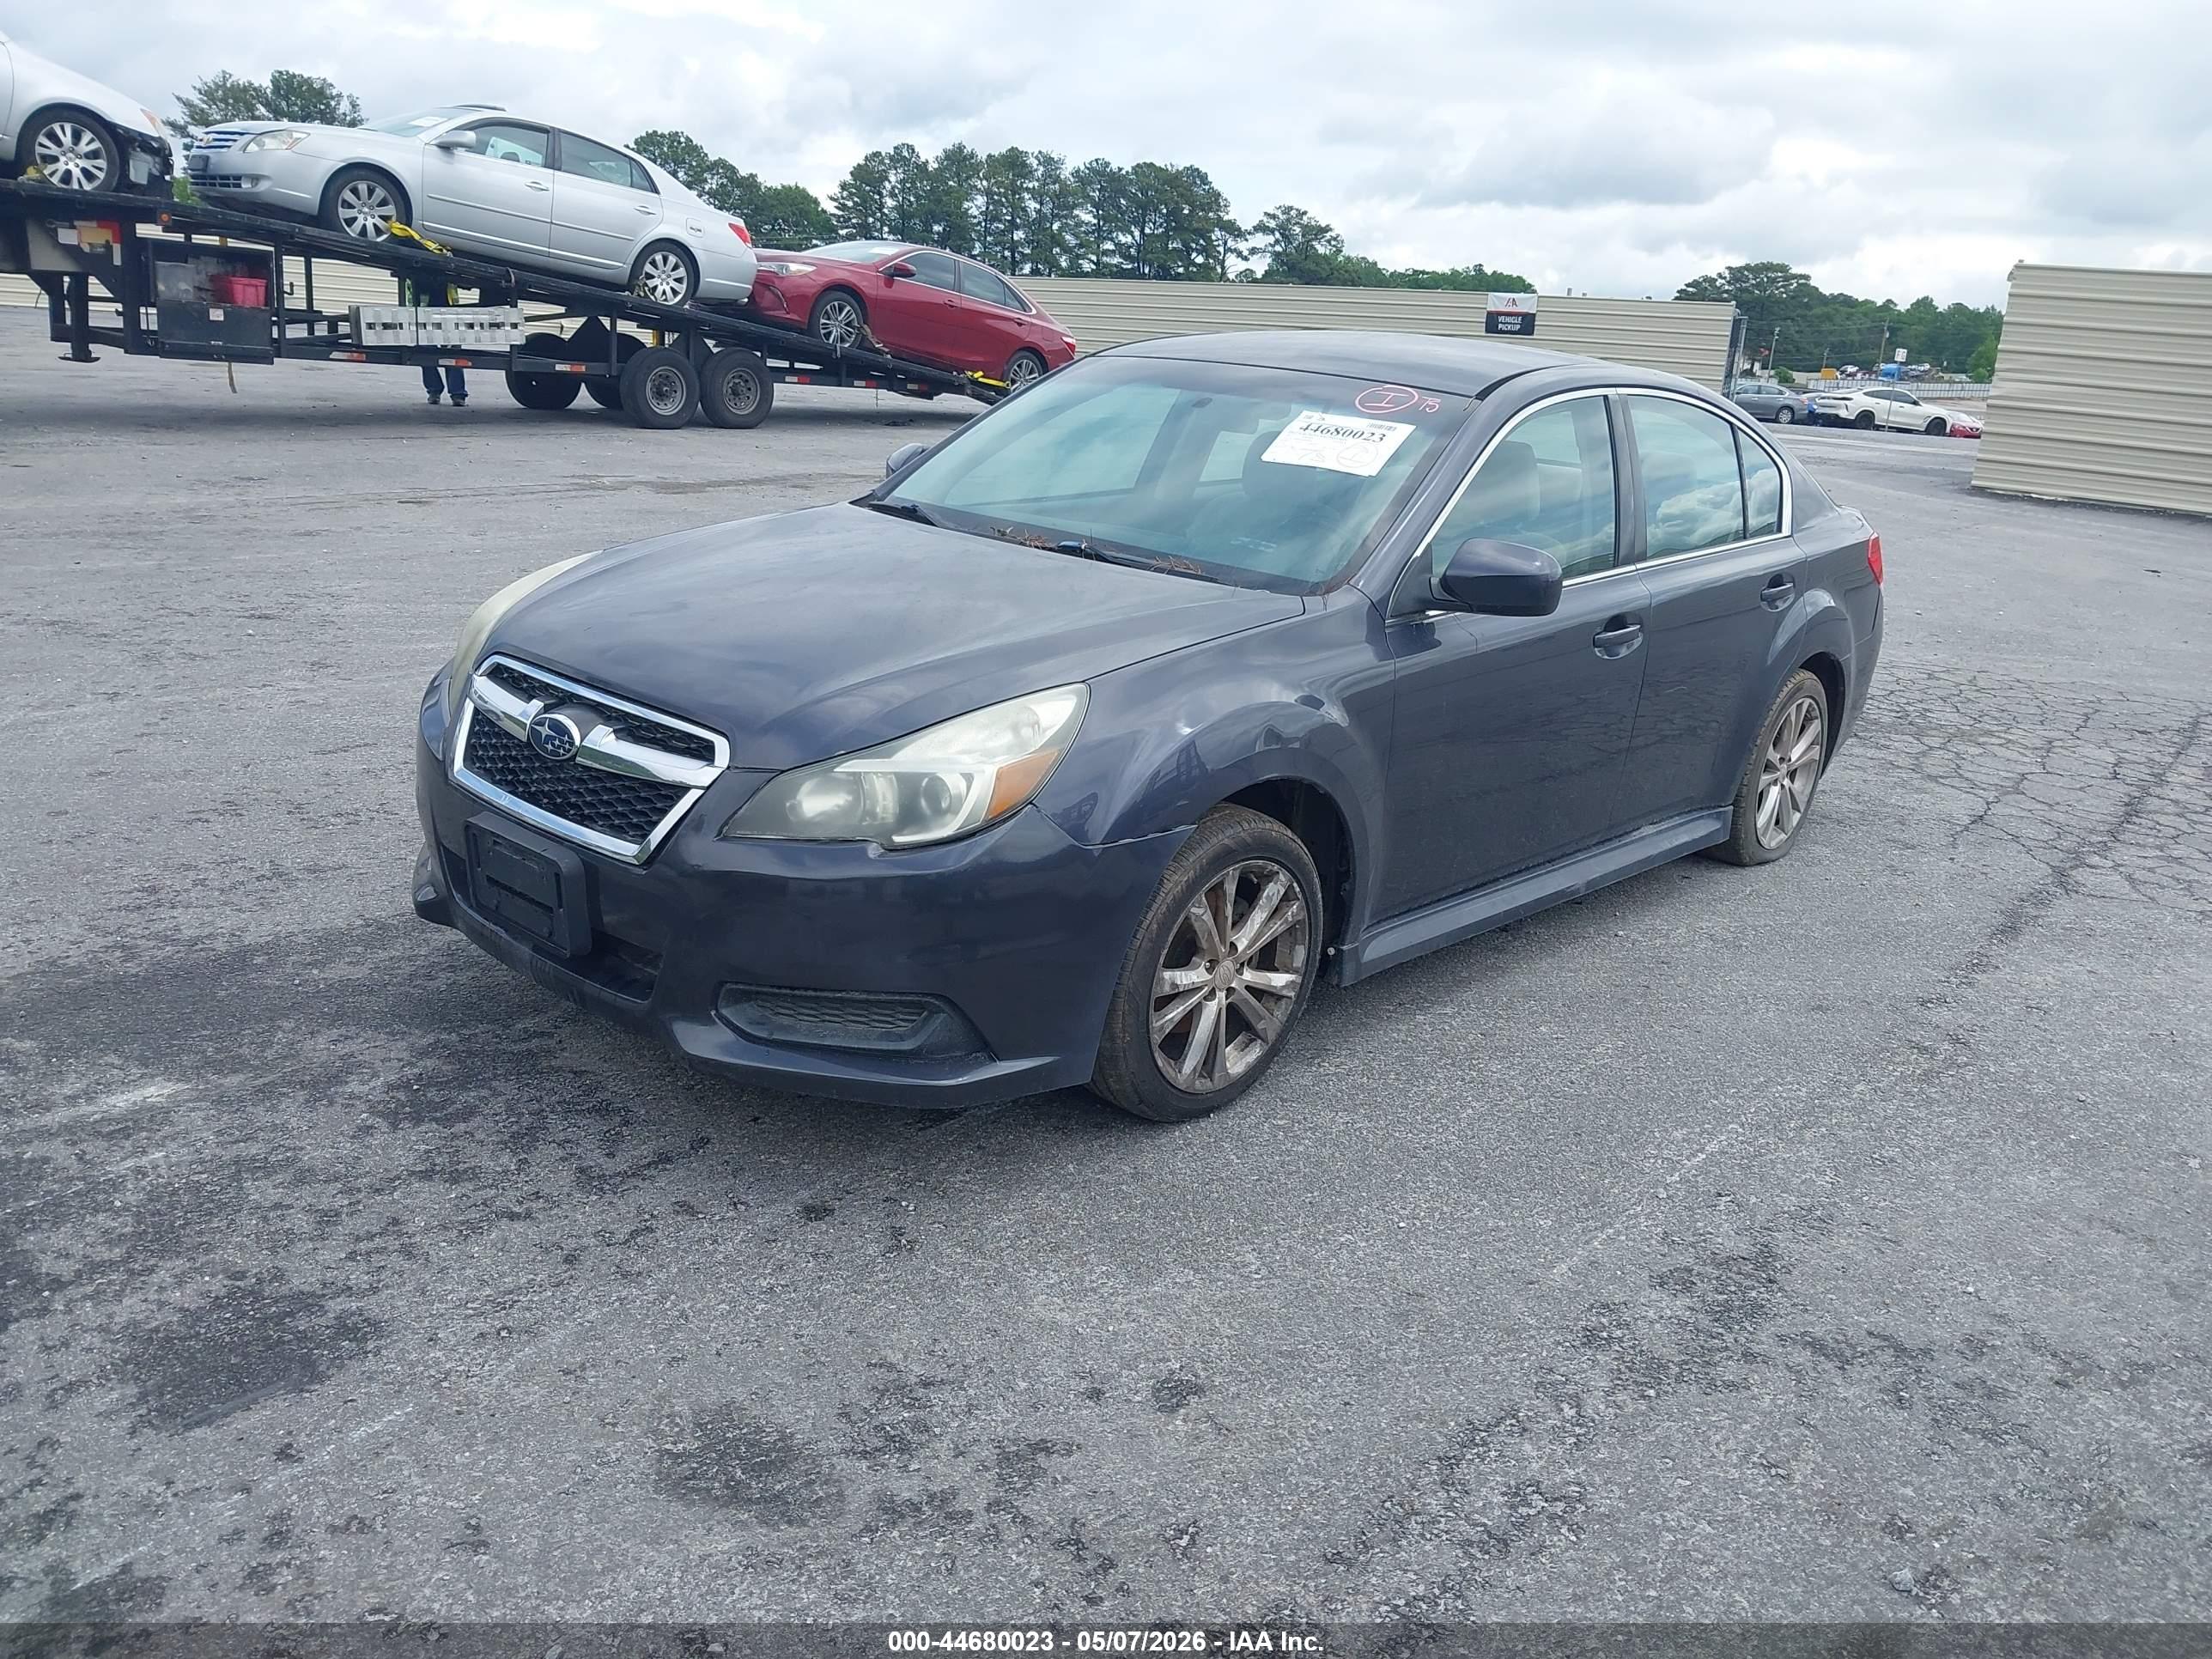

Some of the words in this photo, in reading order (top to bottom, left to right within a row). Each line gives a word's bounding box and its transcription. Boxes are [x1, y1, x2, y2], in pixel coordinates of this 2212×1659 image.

[1498, 315, 1522, 324] VEHICLE
[1498, 323, 1521, 331] PICKUP
[1299, 422, 1387, 443] 44680023
